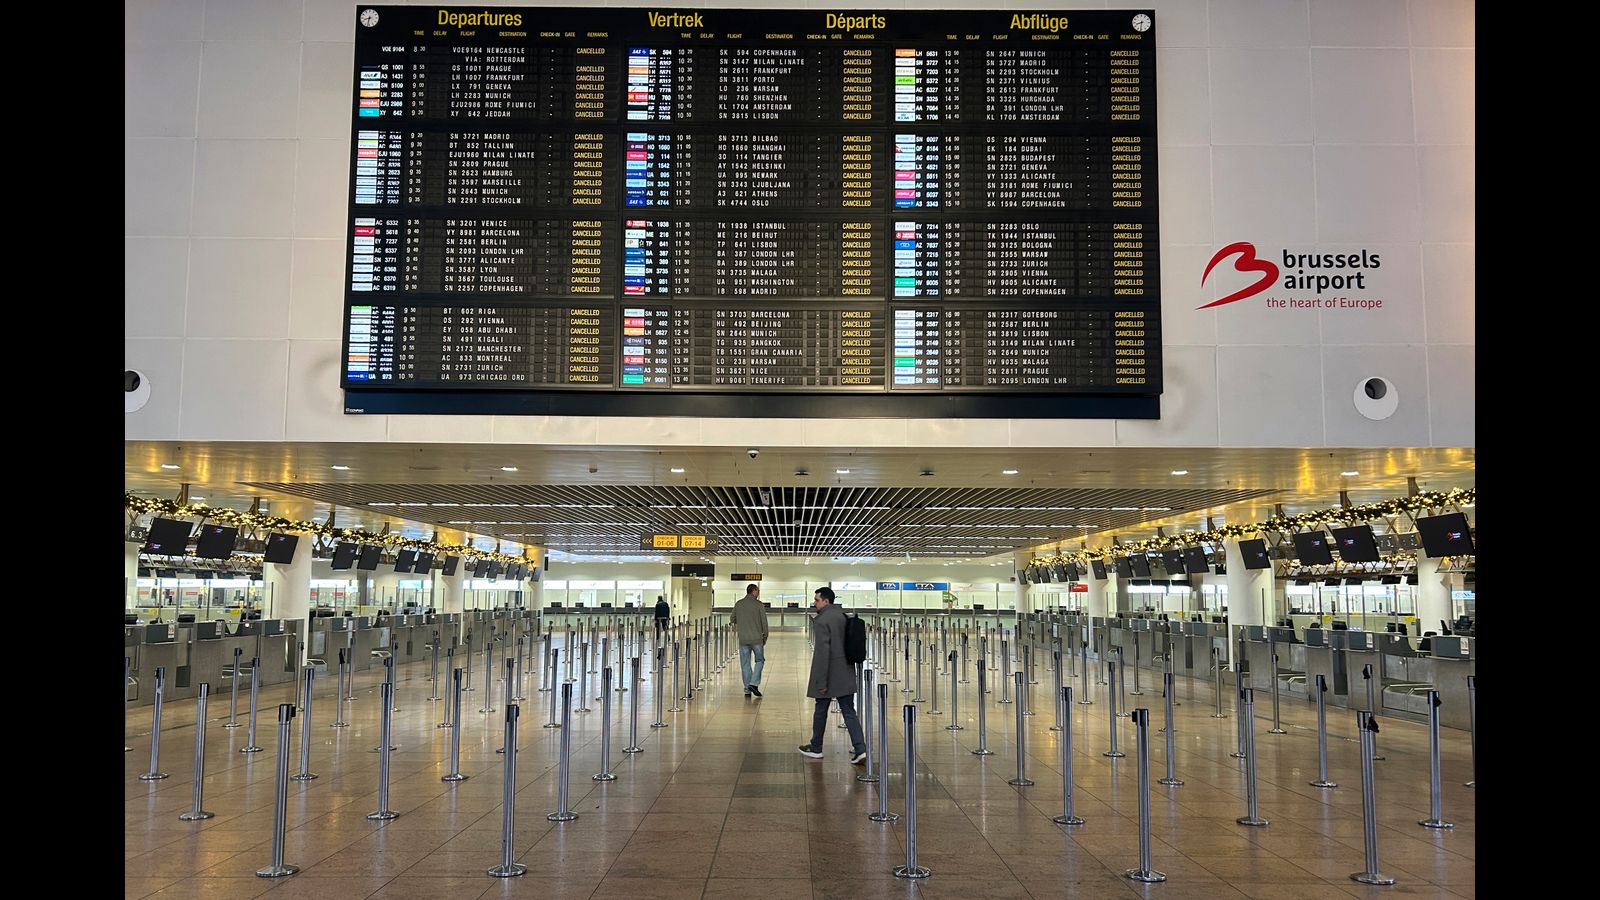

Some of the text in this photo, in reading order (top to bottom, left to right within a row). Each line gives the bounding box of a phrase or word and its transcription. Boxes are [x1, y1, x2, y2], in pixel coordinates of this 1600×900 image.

[438, 10, 522, 28] Departures
[648, 12, 703, 27] Vertrek
[826, 13, 885, 31] Départs
[1010, 14, 1068, 32] Abflüge
[1283, 249, 1380, 268] brussels
[1284, 270, 1365, 294] airport
[1267, 298, 1382, 310] the heart of Europe
